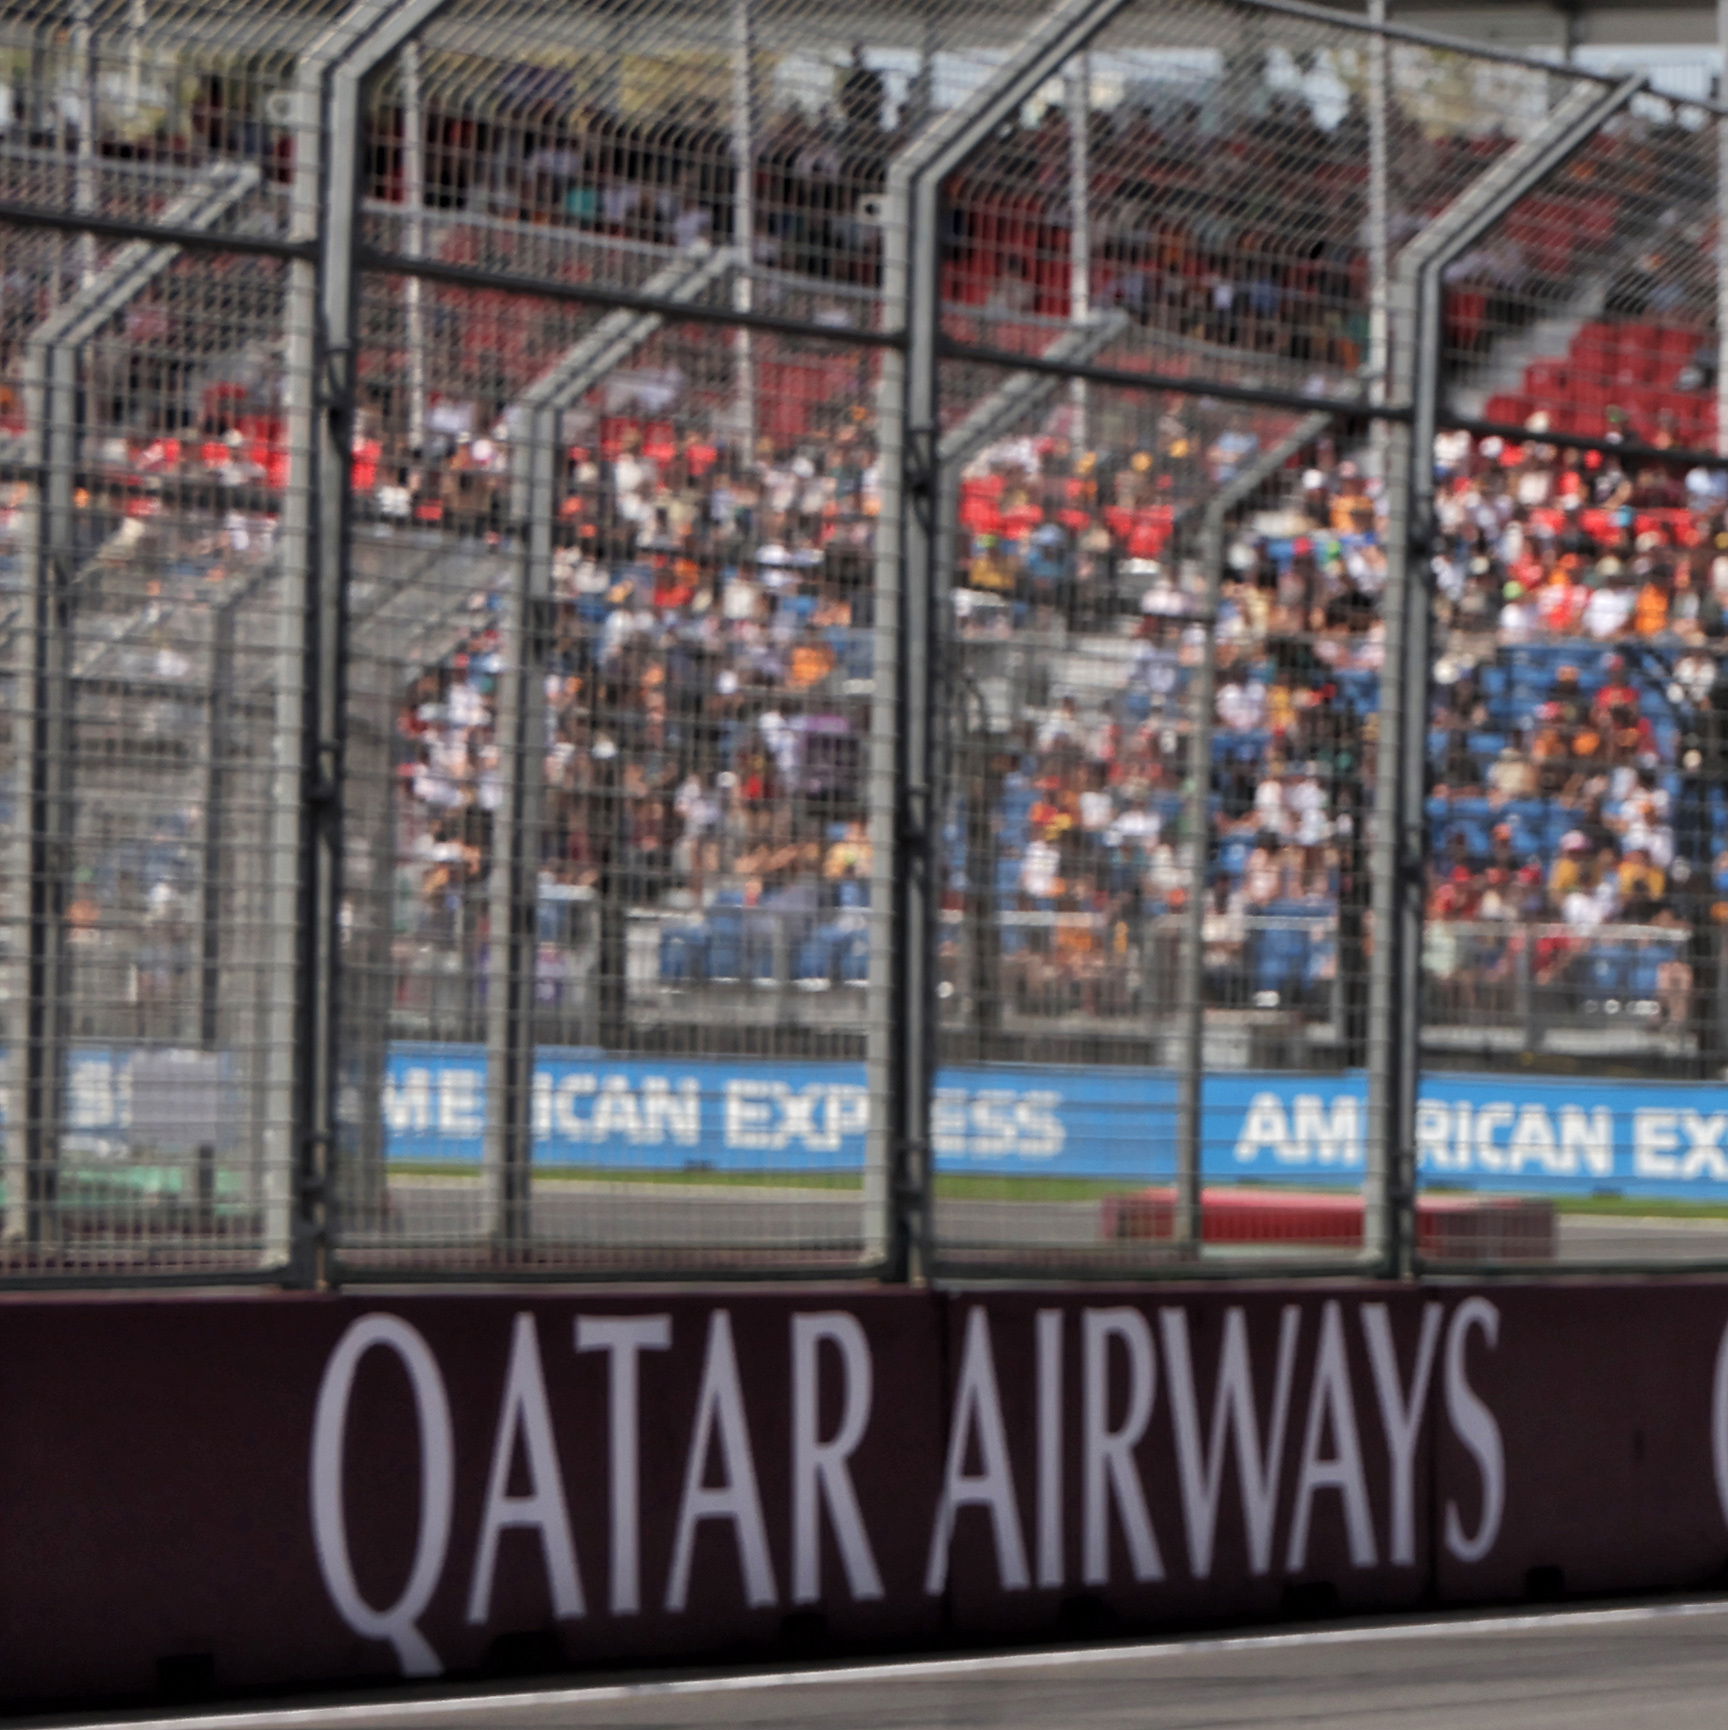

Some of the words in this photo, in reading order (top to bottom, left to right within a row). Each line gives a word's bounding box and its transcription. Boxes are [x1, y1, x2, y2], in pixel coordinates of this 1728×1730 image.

[337, 1063, 702, 1147] MEICAN
[724, 1078, 1067, 1158] EXPESS
[1234, 1091, 1614, 1177] AMRICAN
[309, 1310, 884, 1677] QATAR
[925, 1296, 1506, 1596] AIRWAYS
